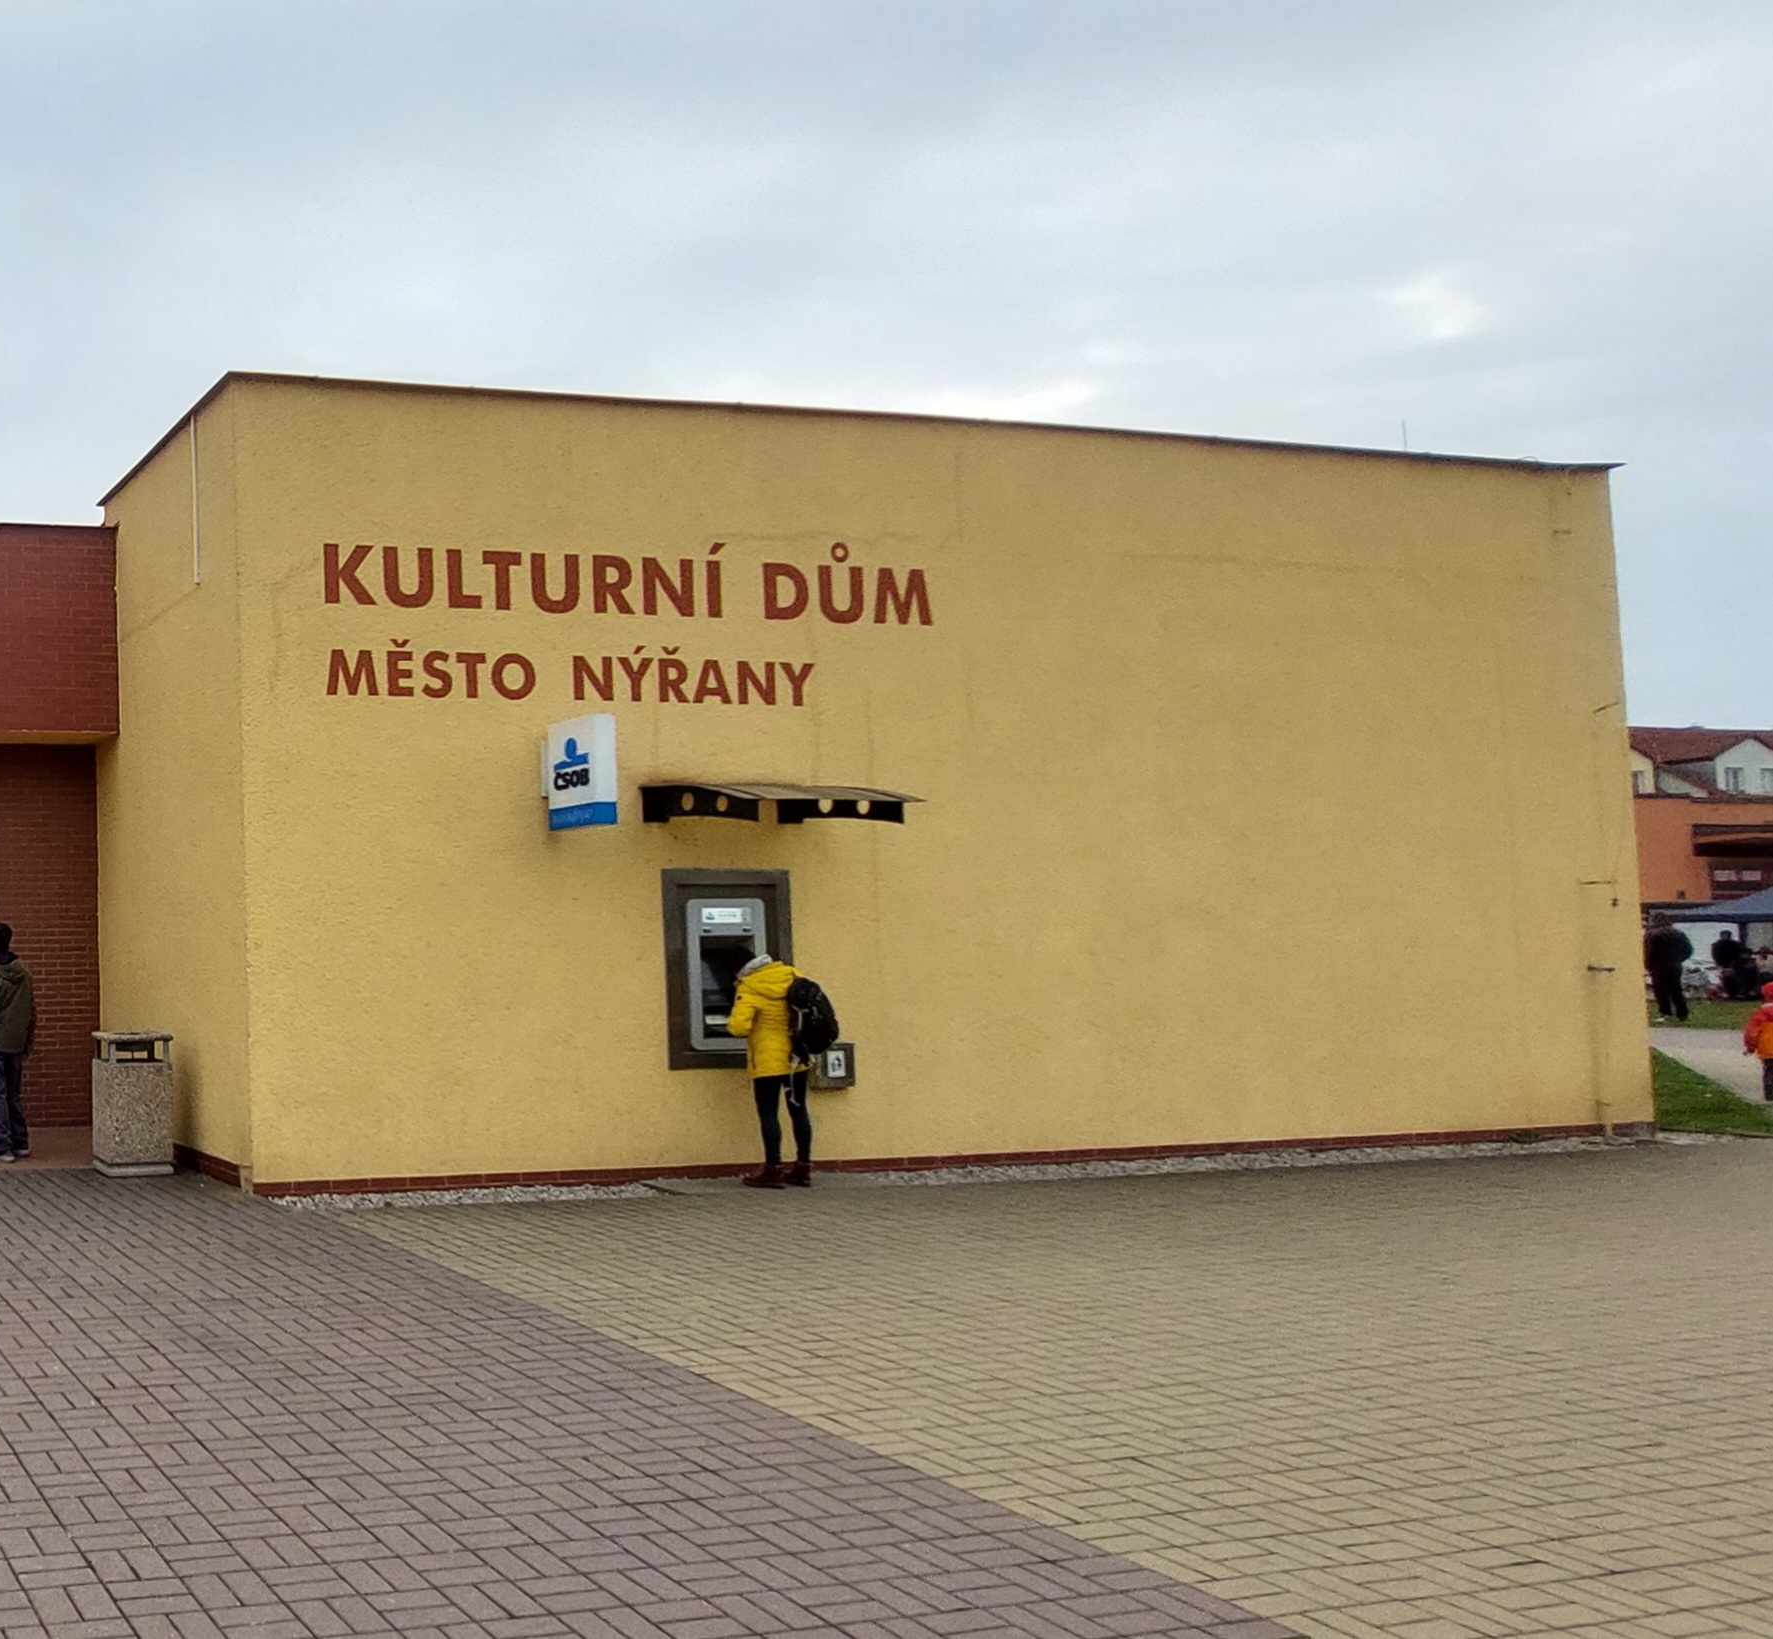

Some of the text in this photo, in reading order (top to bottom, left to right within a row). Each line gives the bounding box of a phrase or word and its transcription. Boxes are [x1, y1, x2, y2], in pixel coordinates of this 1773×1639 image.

[322, 542, 933, 627] KULTURNÍ DŮM
[325, 638, 815, 707] MĚSTO NÝŘANY
[553, 767, 590, 791] ČSOB
